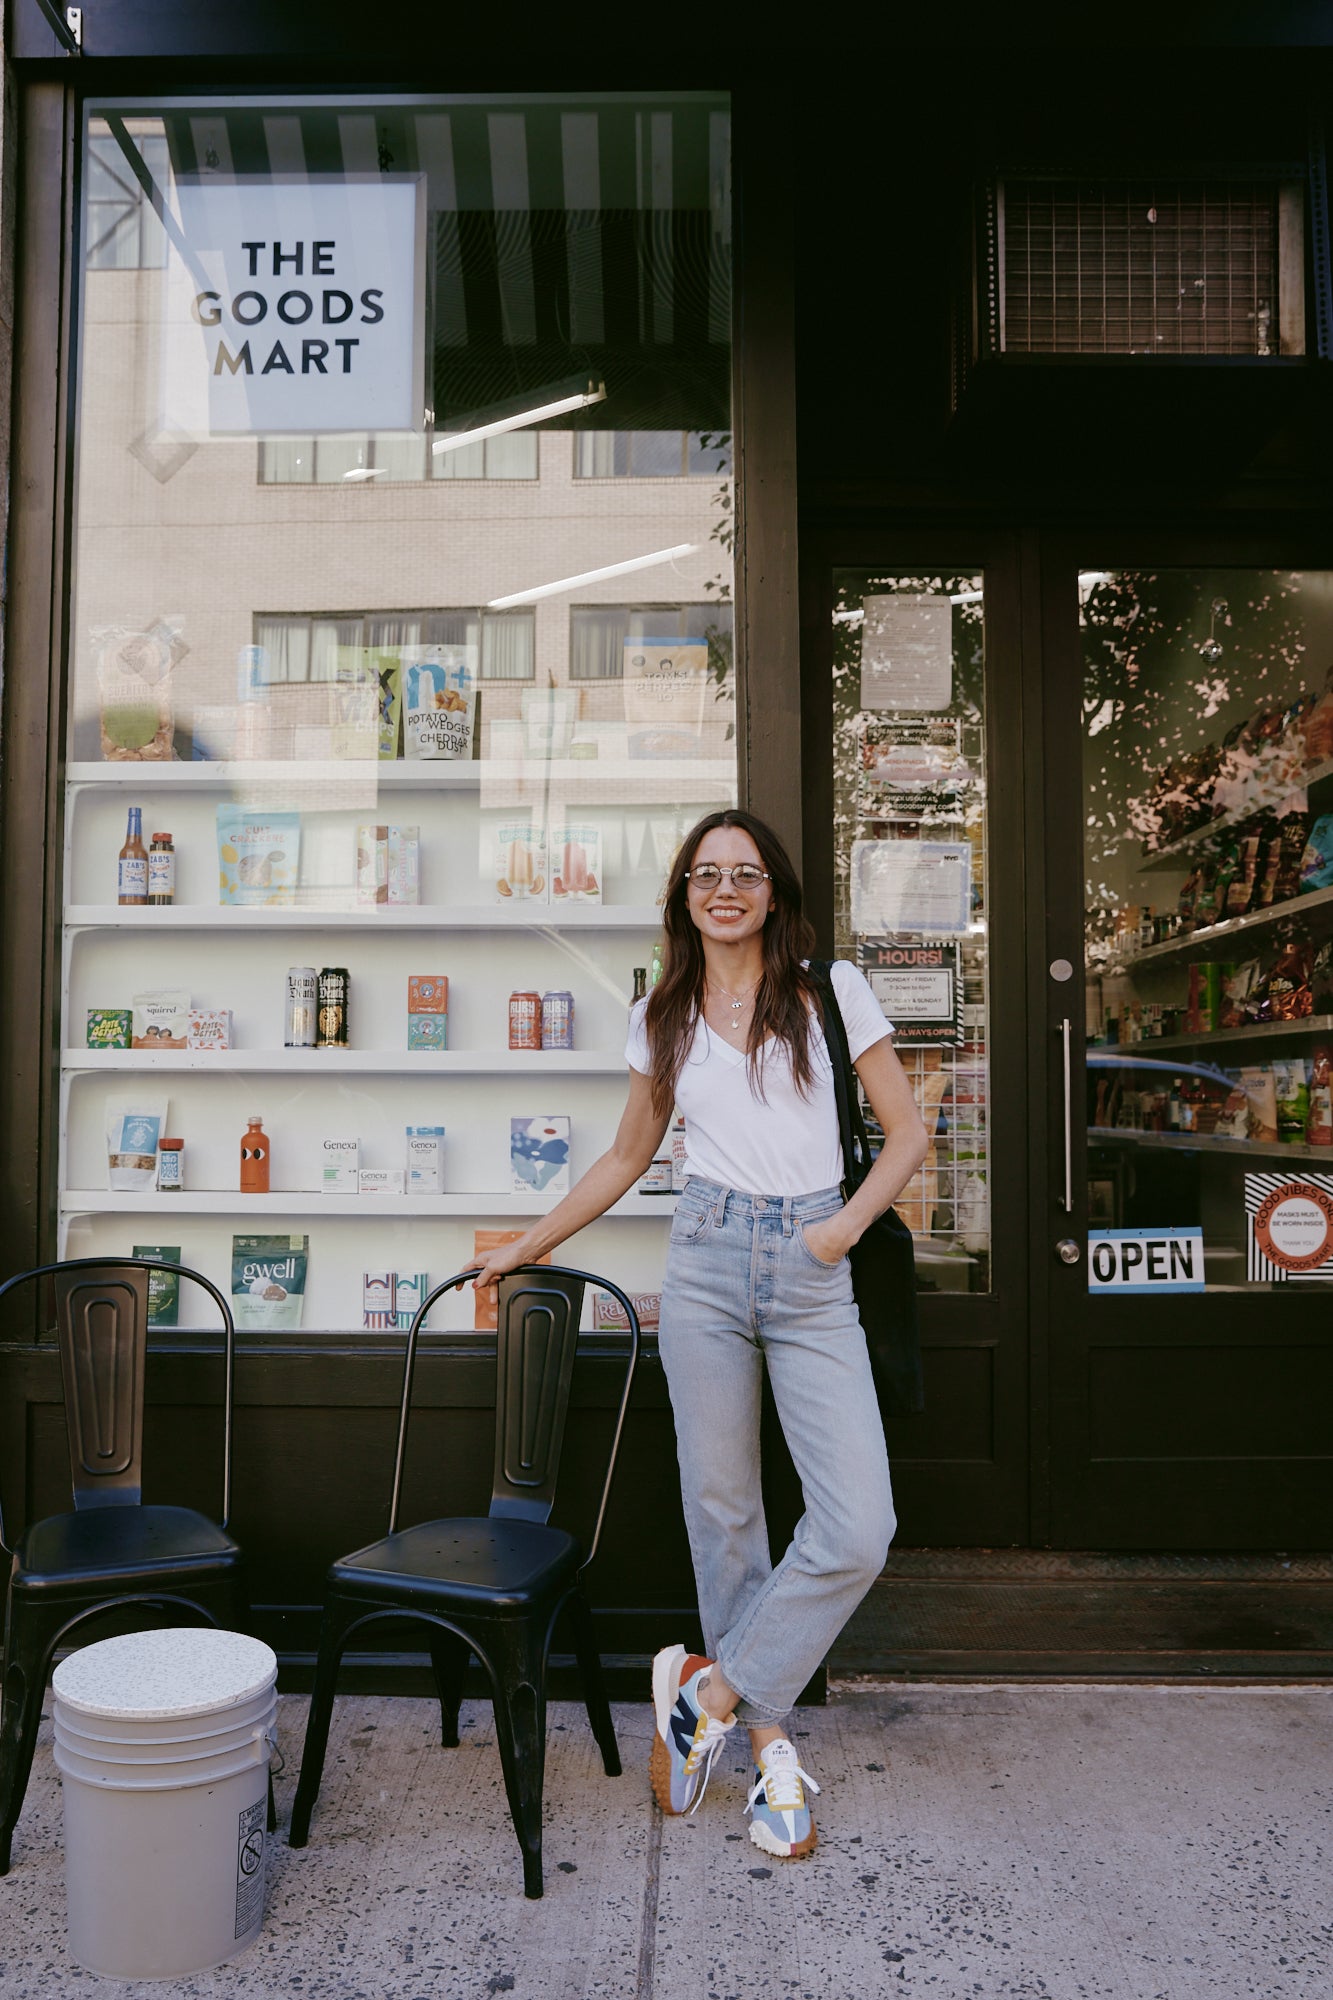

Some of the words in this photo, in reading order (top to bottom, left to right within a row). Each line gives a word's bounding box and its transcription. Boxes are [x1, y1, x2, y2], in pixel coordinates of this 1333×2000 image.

[241, 241, 336, 276] THE
[190, 289, 385, 325] GOODS
[212, 338, 361, 376] MART
[408, 712, 448, 726] POTATO
[428, 720, 471, 736] WEDGES
[420, 733, 468, 749] CHEDDAR
[438, 740, 463, 754] DUST
[127, 862, 145, 870] ZAB'S
[150, 855, 170, 863] ZAB'S
[878, 950, 943, 965] HOURS!
[146, 1006, 177, 1015] squirrel
[510, 1000, 536, 1014] RUBY
[543, 1000, 569, 1013] RUBY
[897, 1028, 932, 1036] ALWAYS
[932, 1028, 957, 1036] OPEN
[323, 1139, 357, 1150] Genexa
[411, 1140, 437, 1149] Genexa
[360, 1170, 388, 1180] Genexa
[1256, 1193, 1280, 1229] GOOD
[1280, 1185, 1318, 1199] VIBES
[1318, 1195, 1333, 1227] ONL
[1092, 1240, 1194, 1283] OPEN
[1264, 1241, 1278, 1260] THE
[1278, 1257, 1312, 1269] GOODS
[1311, 1243, 1332, 1265] MART
[242, 1258, 296, 1286] gwell
